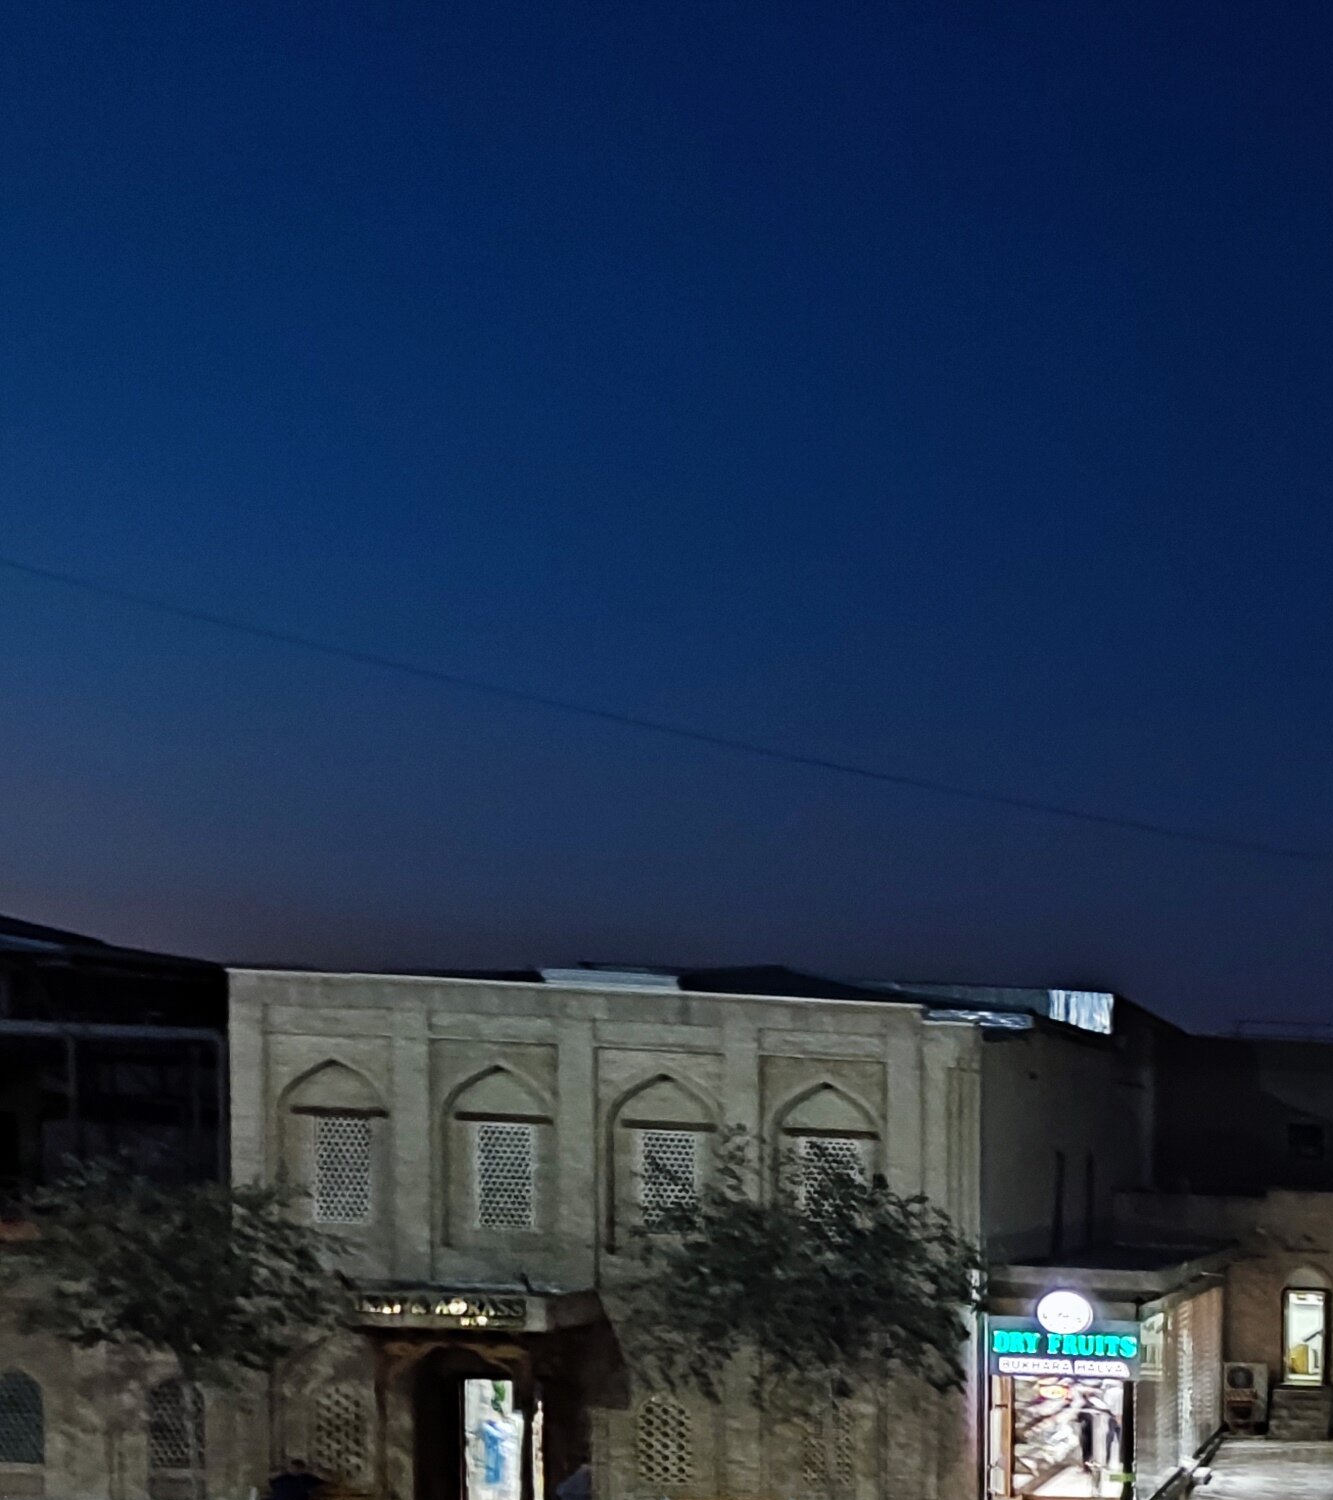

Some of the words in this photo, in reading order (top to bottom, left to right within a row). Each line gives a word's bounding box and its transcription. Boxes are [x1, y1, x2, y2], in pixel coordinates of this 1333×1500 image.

[993, 1330, 1041, 1354] DRY
[1047, 1333, 1138, 1358] FRUITS
[1000, 1359, 1072, 1373] BUKHARA
[1075, 1362, 1127, 1376] HALVA
